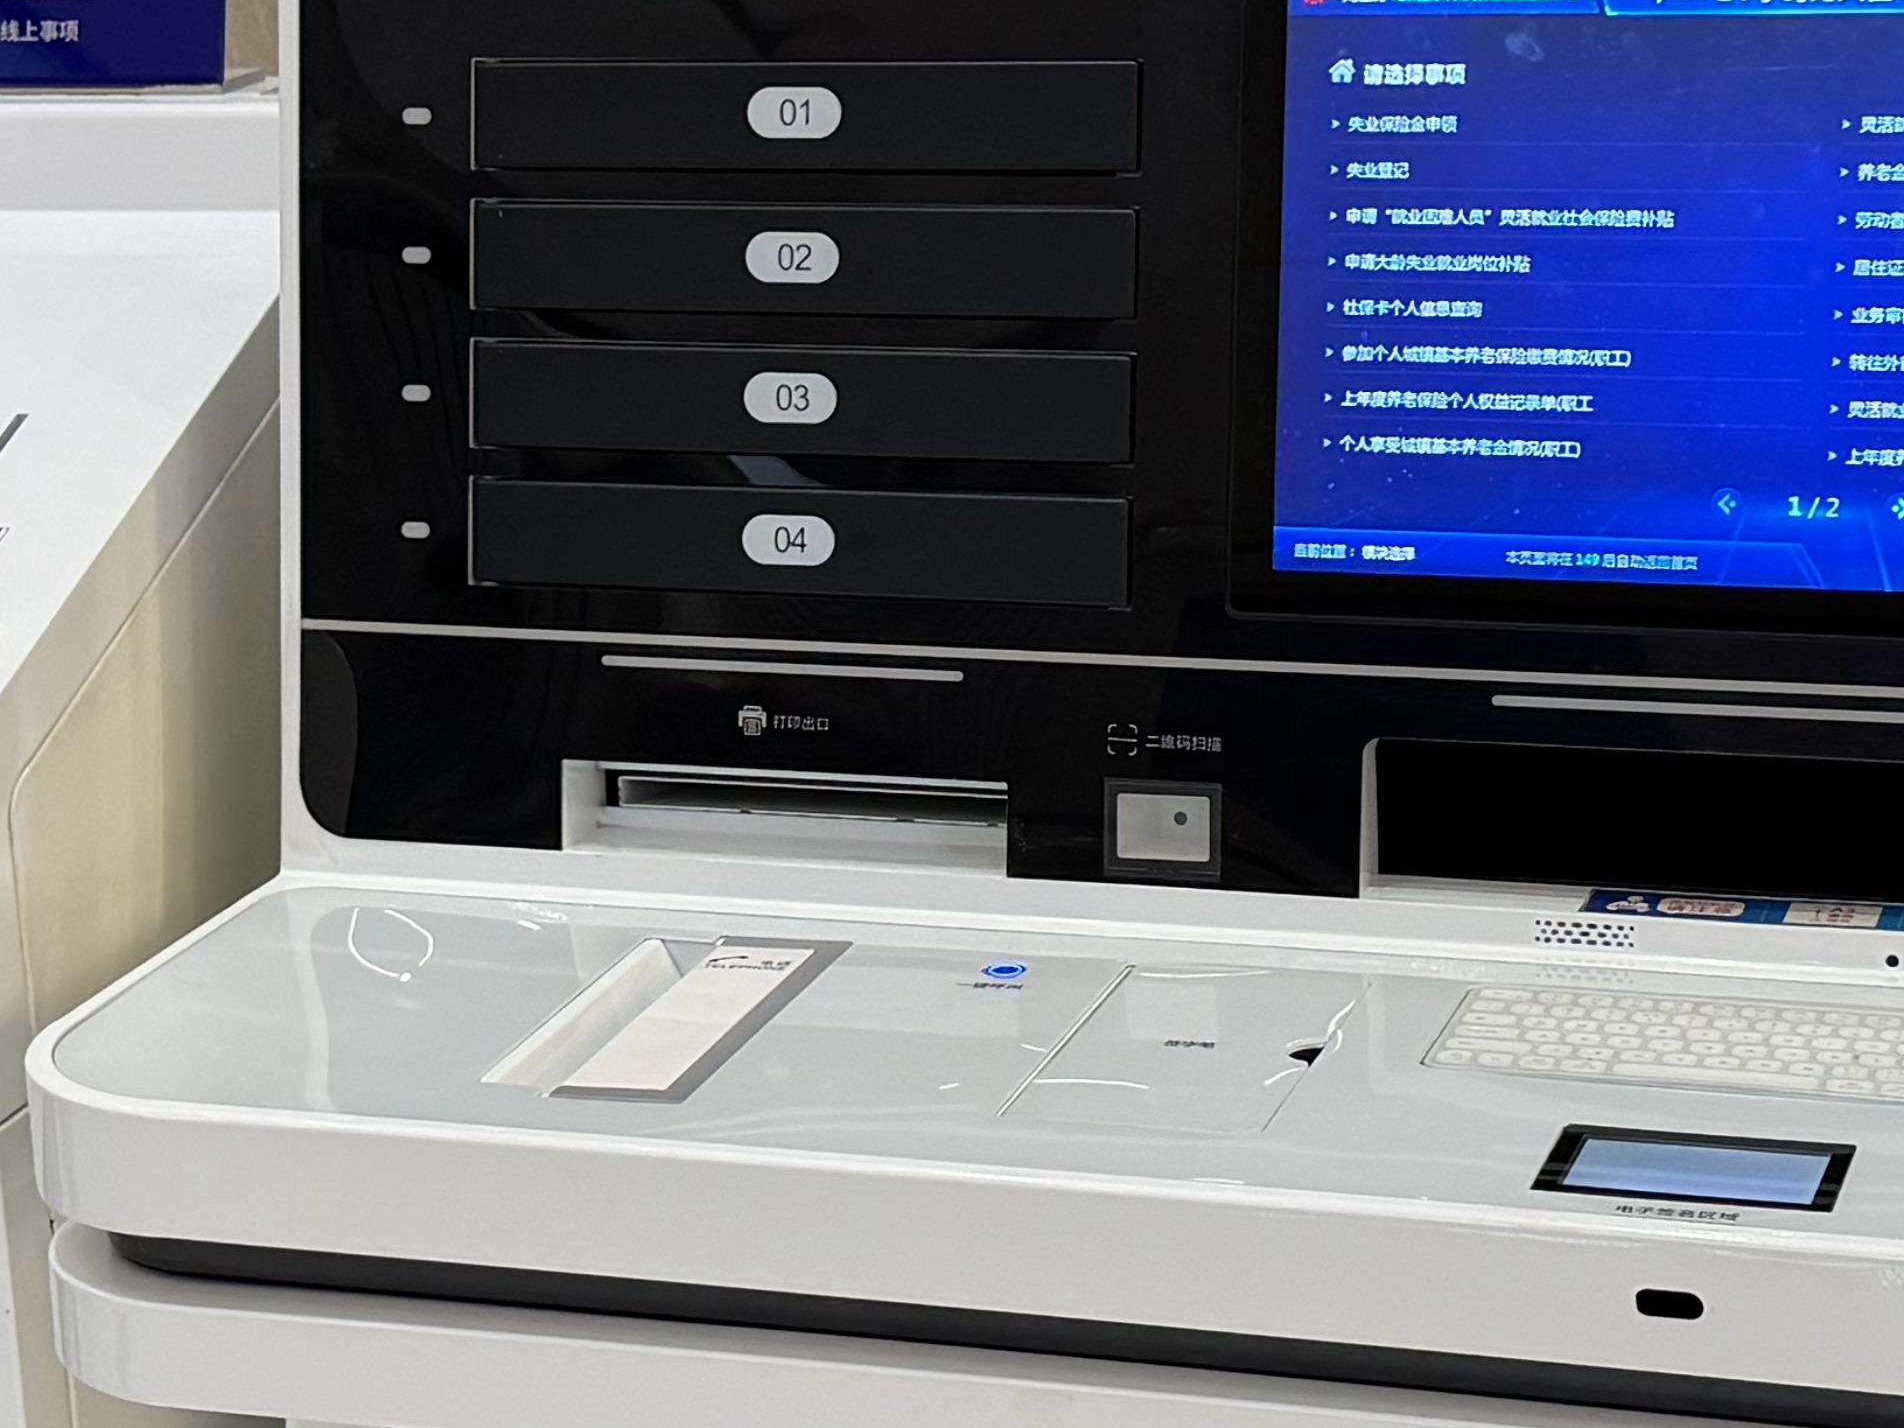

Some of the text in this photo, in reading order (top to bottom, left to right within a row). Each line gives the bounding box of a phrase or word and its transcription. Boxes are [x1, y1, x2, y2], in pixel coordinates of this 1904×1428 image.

[1363, 62, 1467, 86] 请选择事项
[778, 98, 813, 127] 01
[776, 242, 813, 272] 02
[775, 384, 811, 412] 03
[773, 527, 809, 554] 04
[772, 713, 831, 733] 打印出口
[1144, 732, 1223, 754] 二维码扫描
